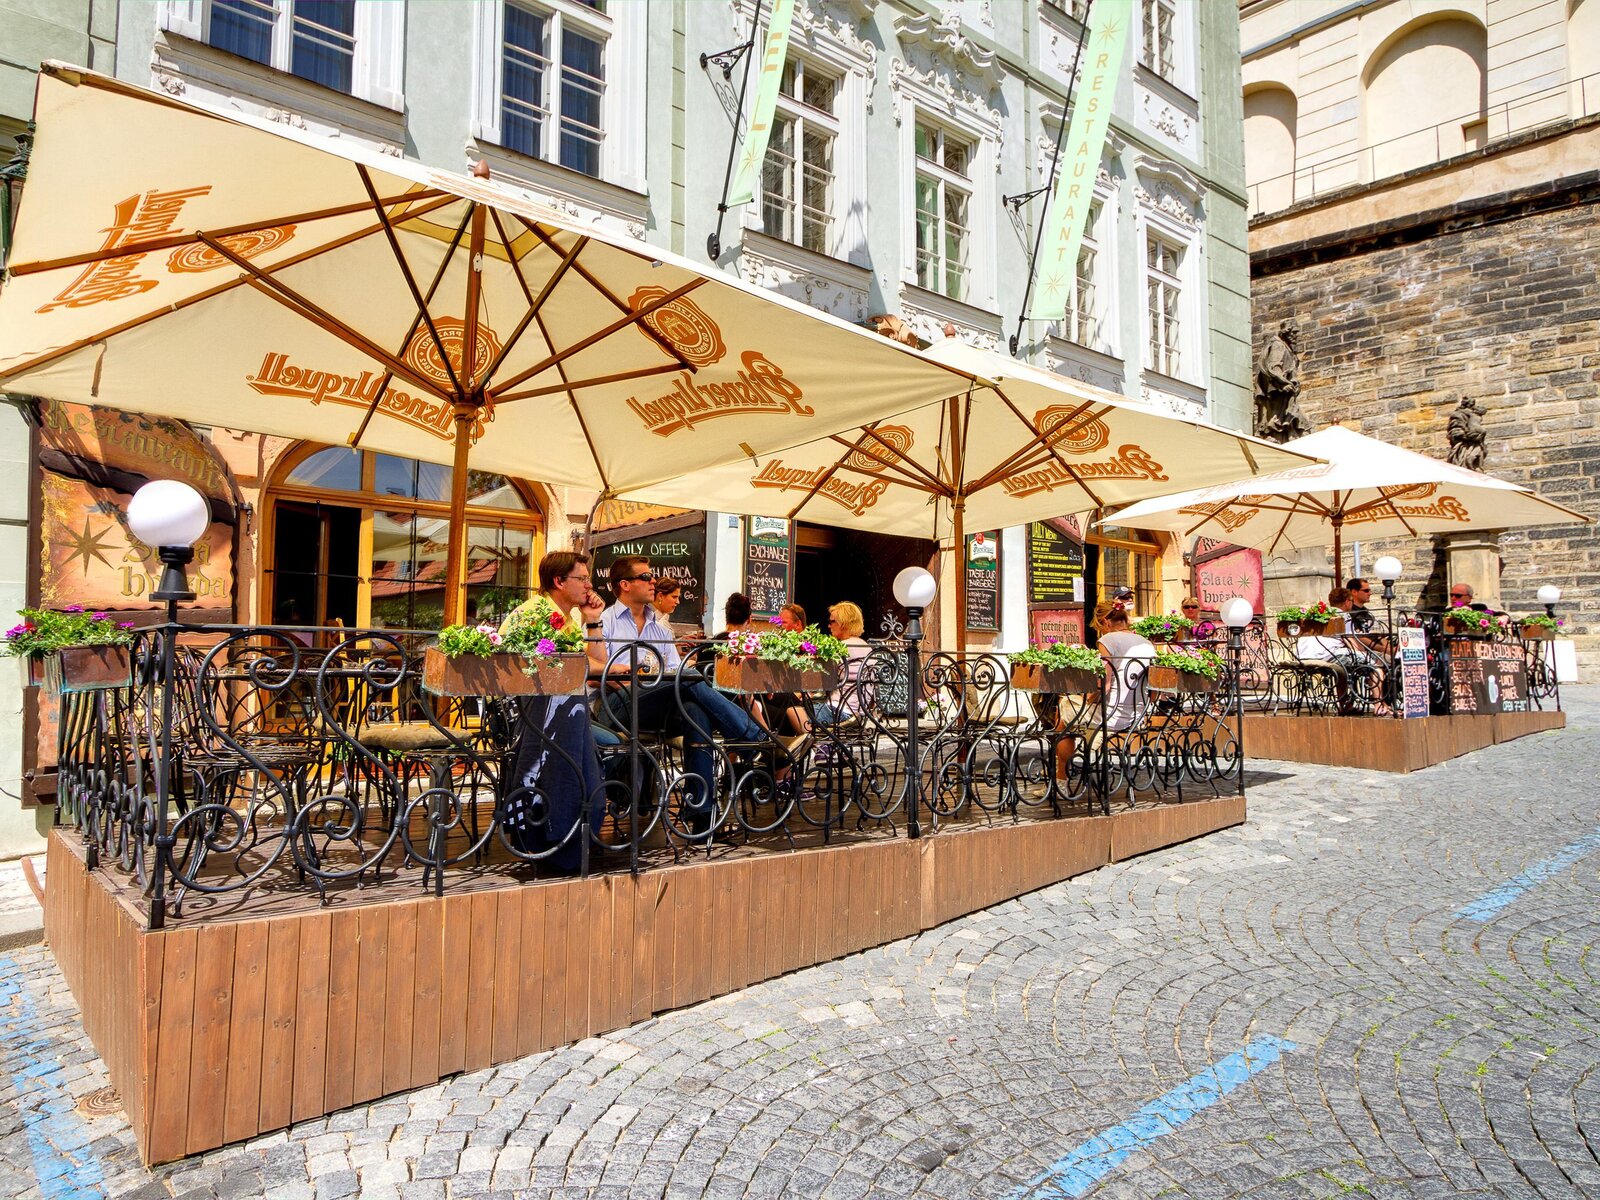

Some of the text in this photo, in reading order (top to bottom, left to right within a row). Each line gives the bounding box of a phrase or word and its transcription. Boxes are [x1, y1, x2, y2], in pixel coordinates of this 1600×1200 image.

[751, 0, 783, 131] EL
[1056, 53, 1110, 262] RESTAURANT
[612, 542, 691, 556] DAILY OFFER
[749, 544, 789, 561] EXCHANGE
[662, 565, 692, 579] AFRICA
